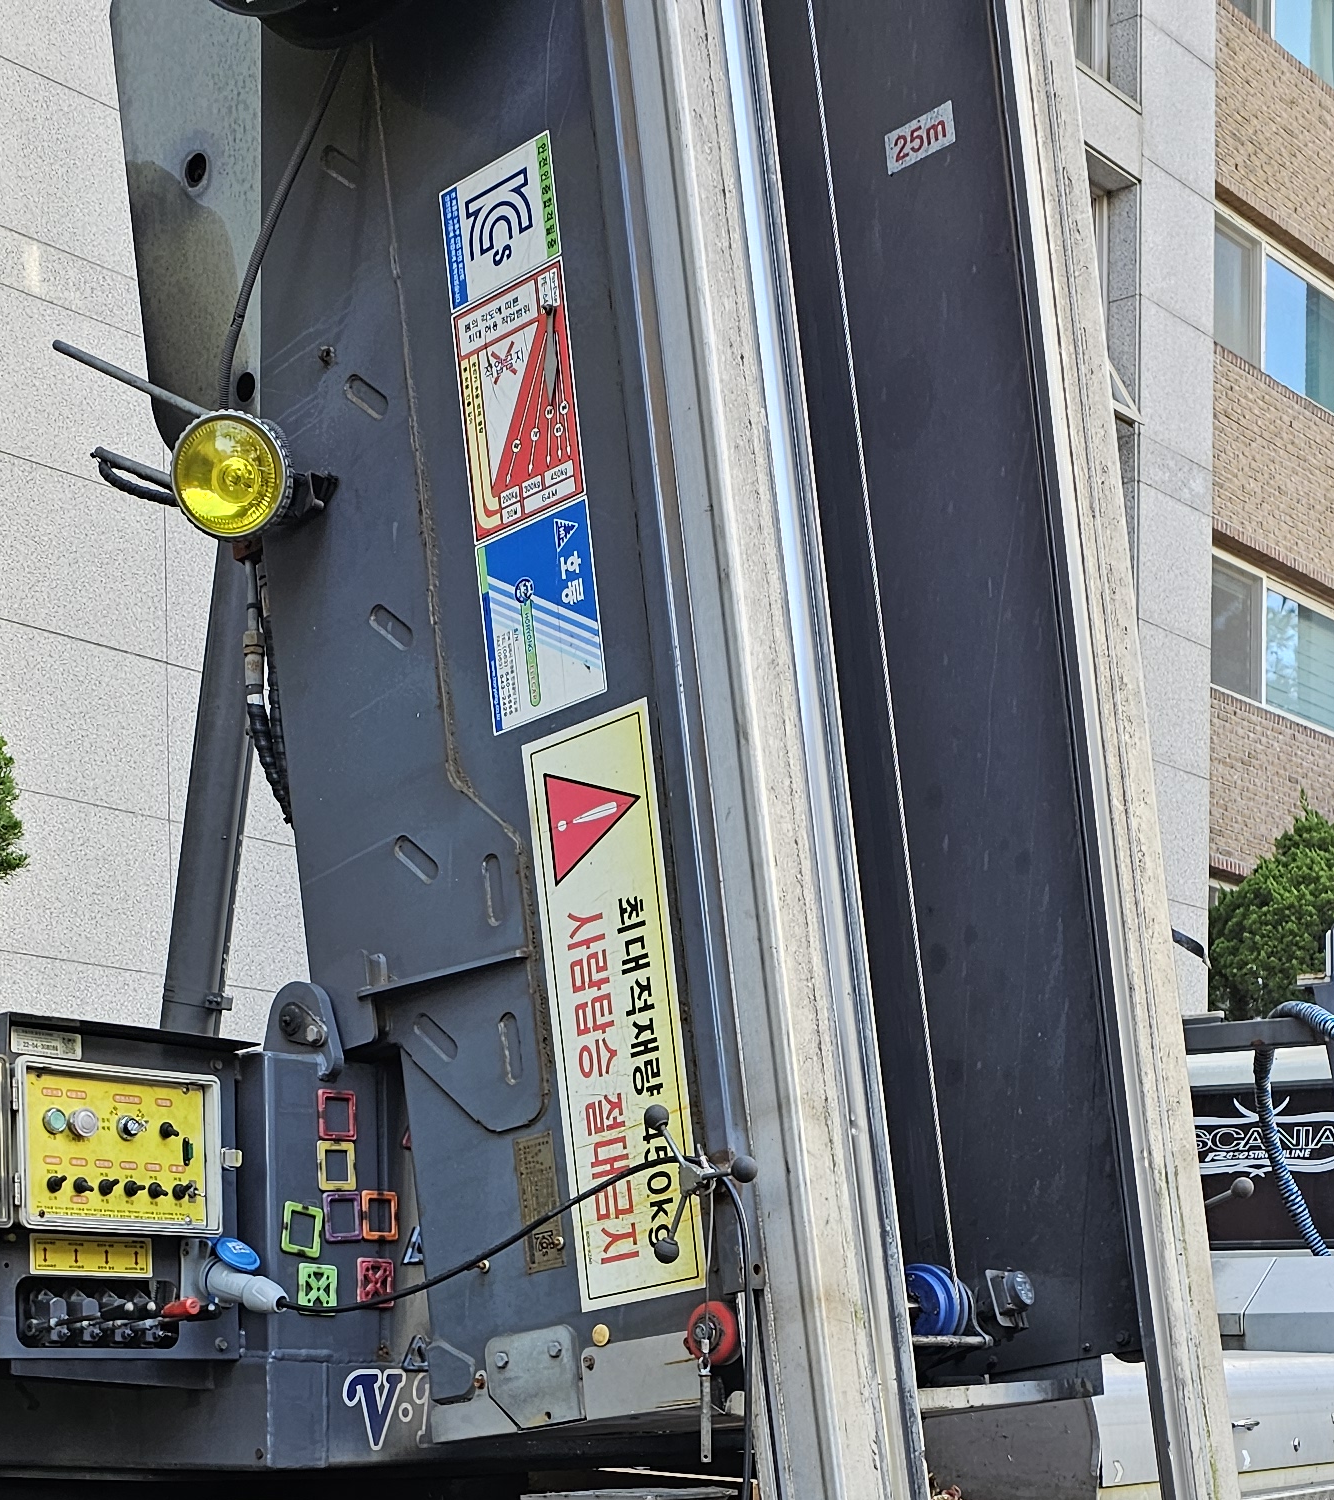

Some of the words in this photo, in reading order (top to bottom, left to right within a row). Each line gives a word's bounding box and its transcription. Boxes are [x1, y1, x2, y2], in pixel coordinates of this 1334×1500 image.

[894, 119, 947, 163] 25m
[560, 551, 585, 605] 호룡
[566, 911, 619, 1079] 사람탑승
[617, 895, 664, 1098] 최대적재량
[585, 1093, 640, 1265] 절대금지
